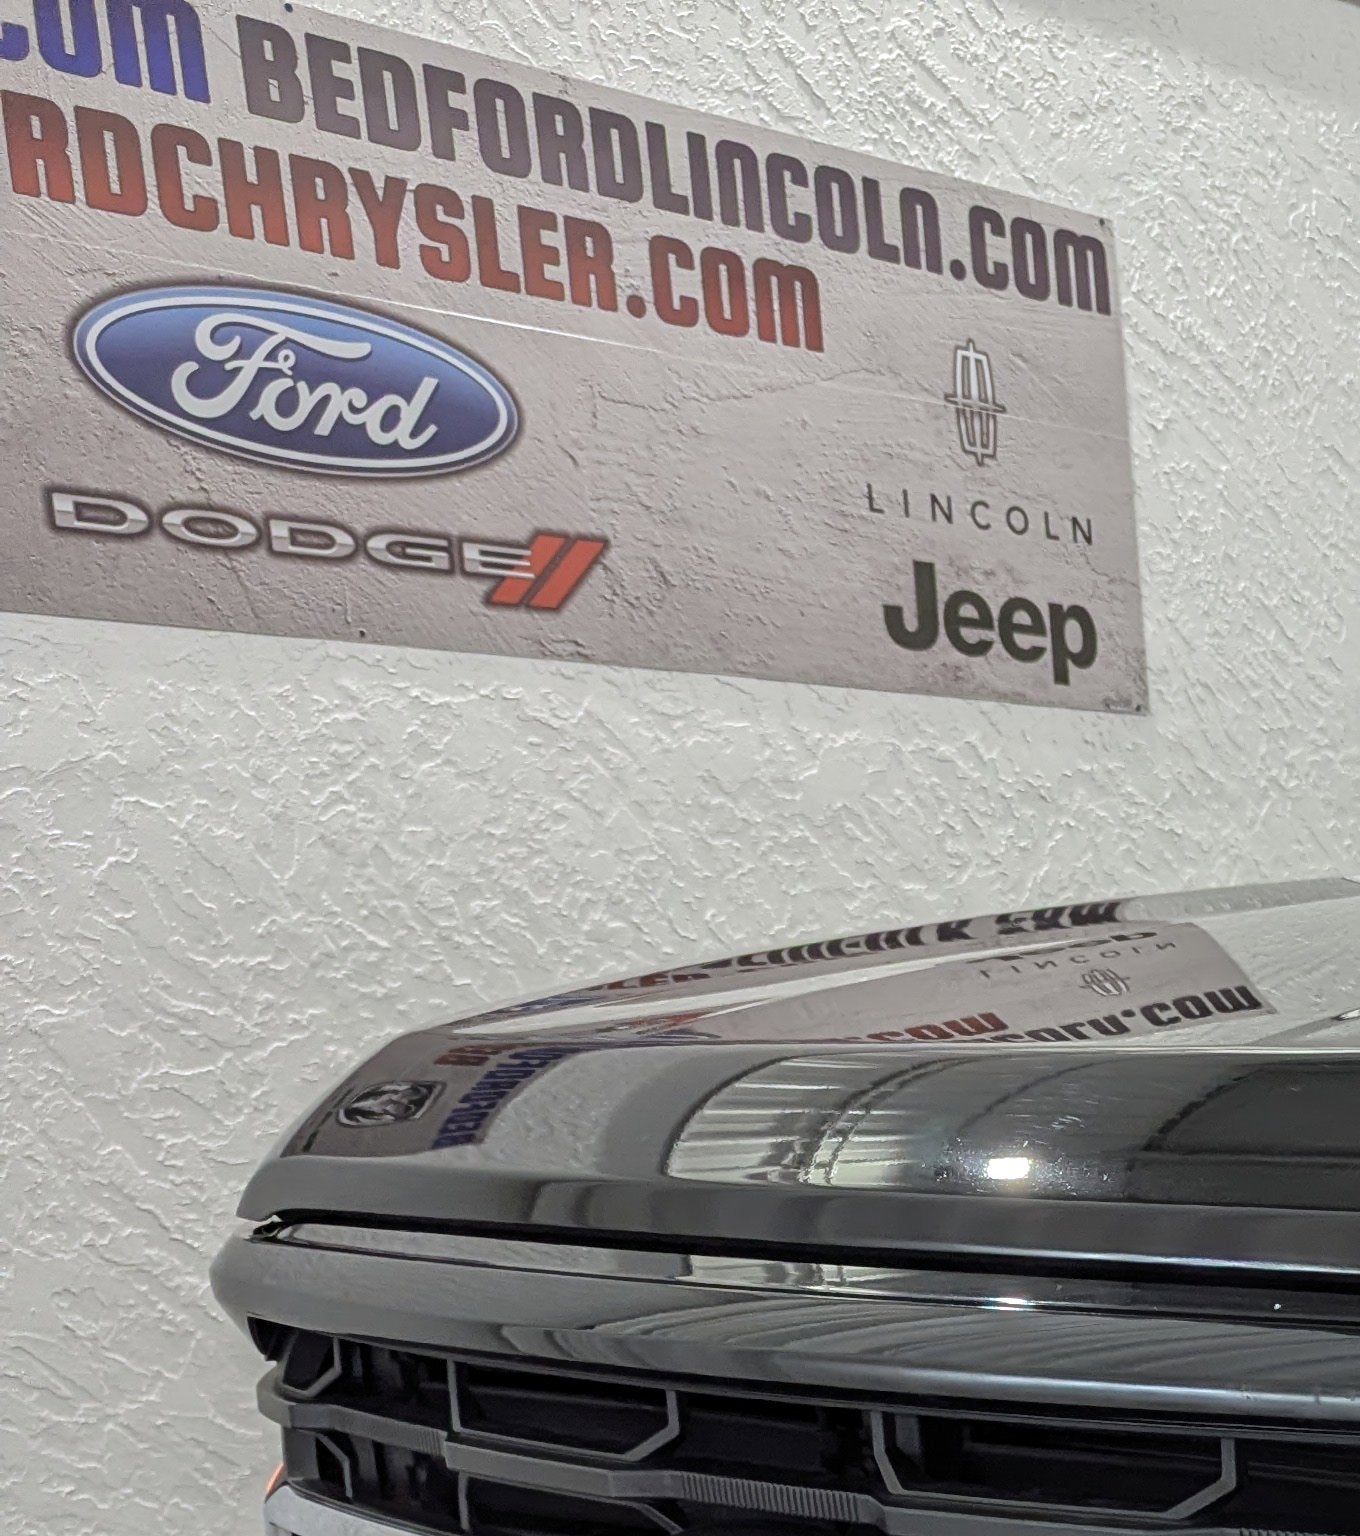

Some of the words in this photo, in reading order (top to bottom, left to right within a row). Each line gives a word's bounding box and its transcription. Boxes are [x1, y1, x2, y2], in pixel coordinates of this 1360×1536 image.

[1, 89, 825, 353] RDCHRYSLER.COM
[236, 14, 1112, 317] BEDFORDLINCOLN.COM
[171, 312, 440, 451] Ford
[51, 491, 535, 579] DODGE
[866, 483, 1093, 546] LINCOLN
[882, 559, 1098, 686] Jeep
